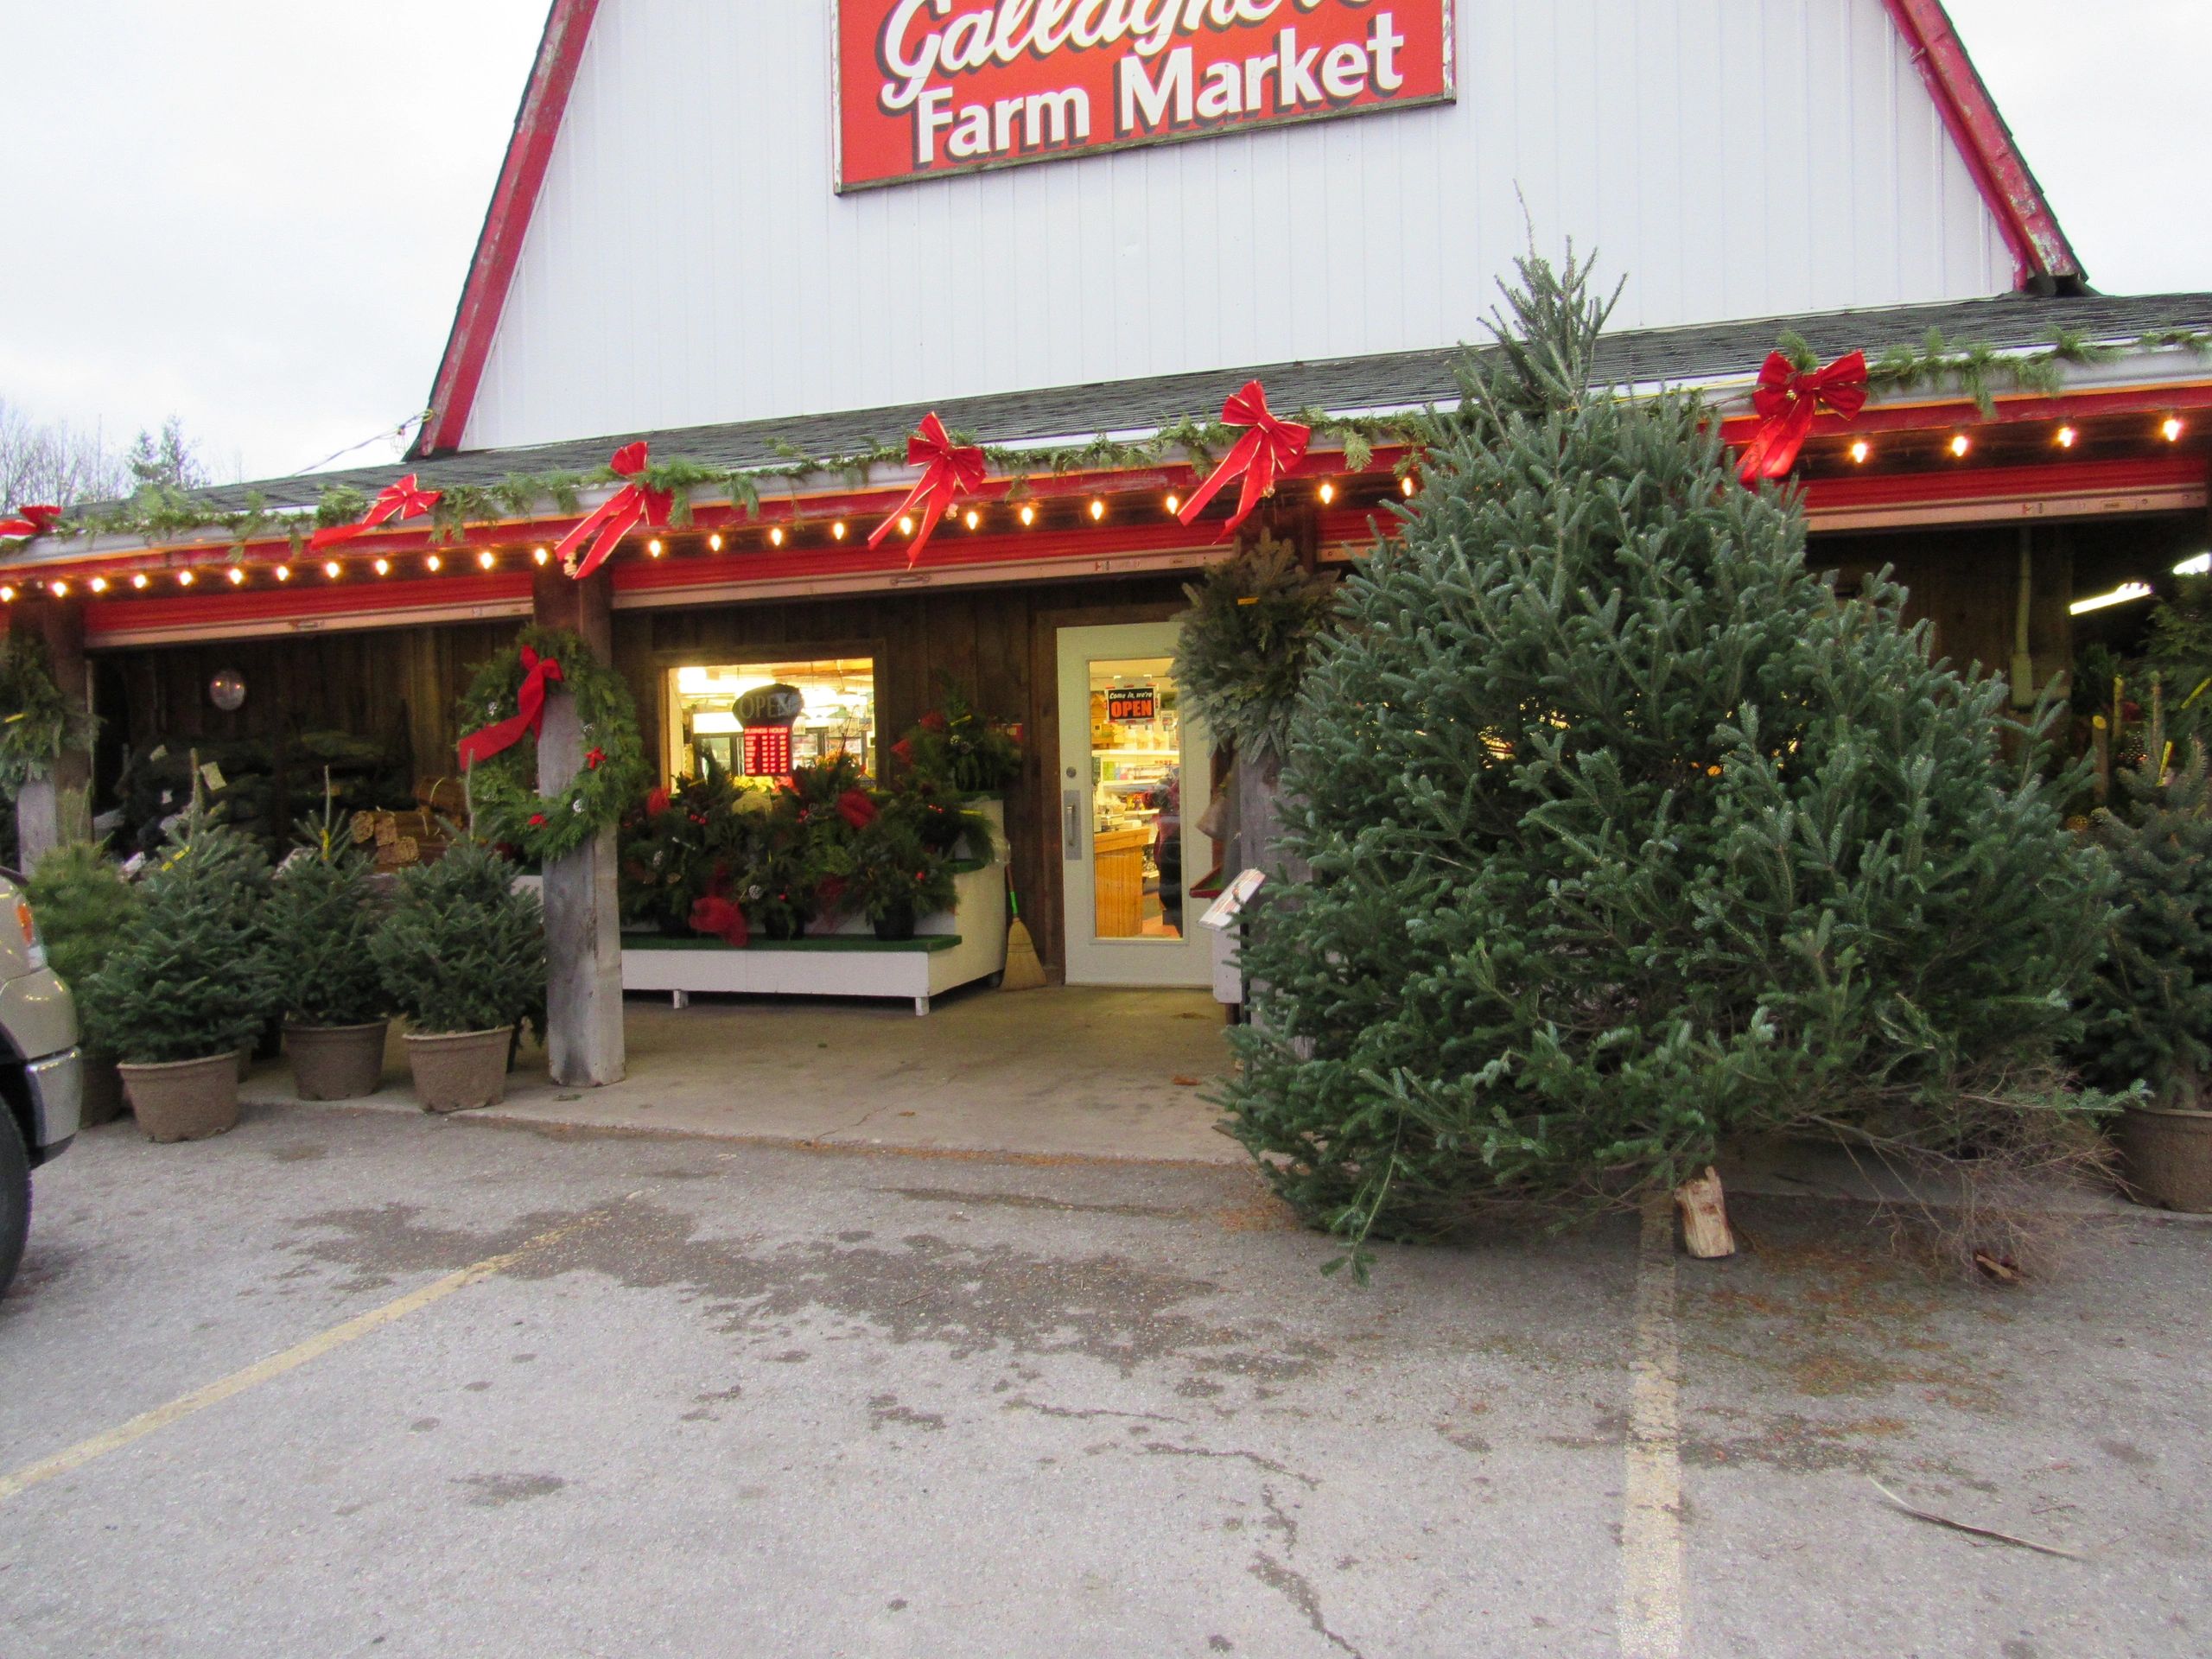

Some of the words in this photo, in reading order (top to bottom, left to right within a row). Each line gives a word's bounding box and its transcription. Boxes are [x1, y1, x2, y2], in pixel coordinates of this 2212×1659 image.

[881, 0, 1374, 108] Gallag
[918, 87, 1090, 163] Farm
[1121, 12, 1405, 131] Market
[740, 694, 792, 719] OPEN
[1110, 700, 1152, 718] OPEN
